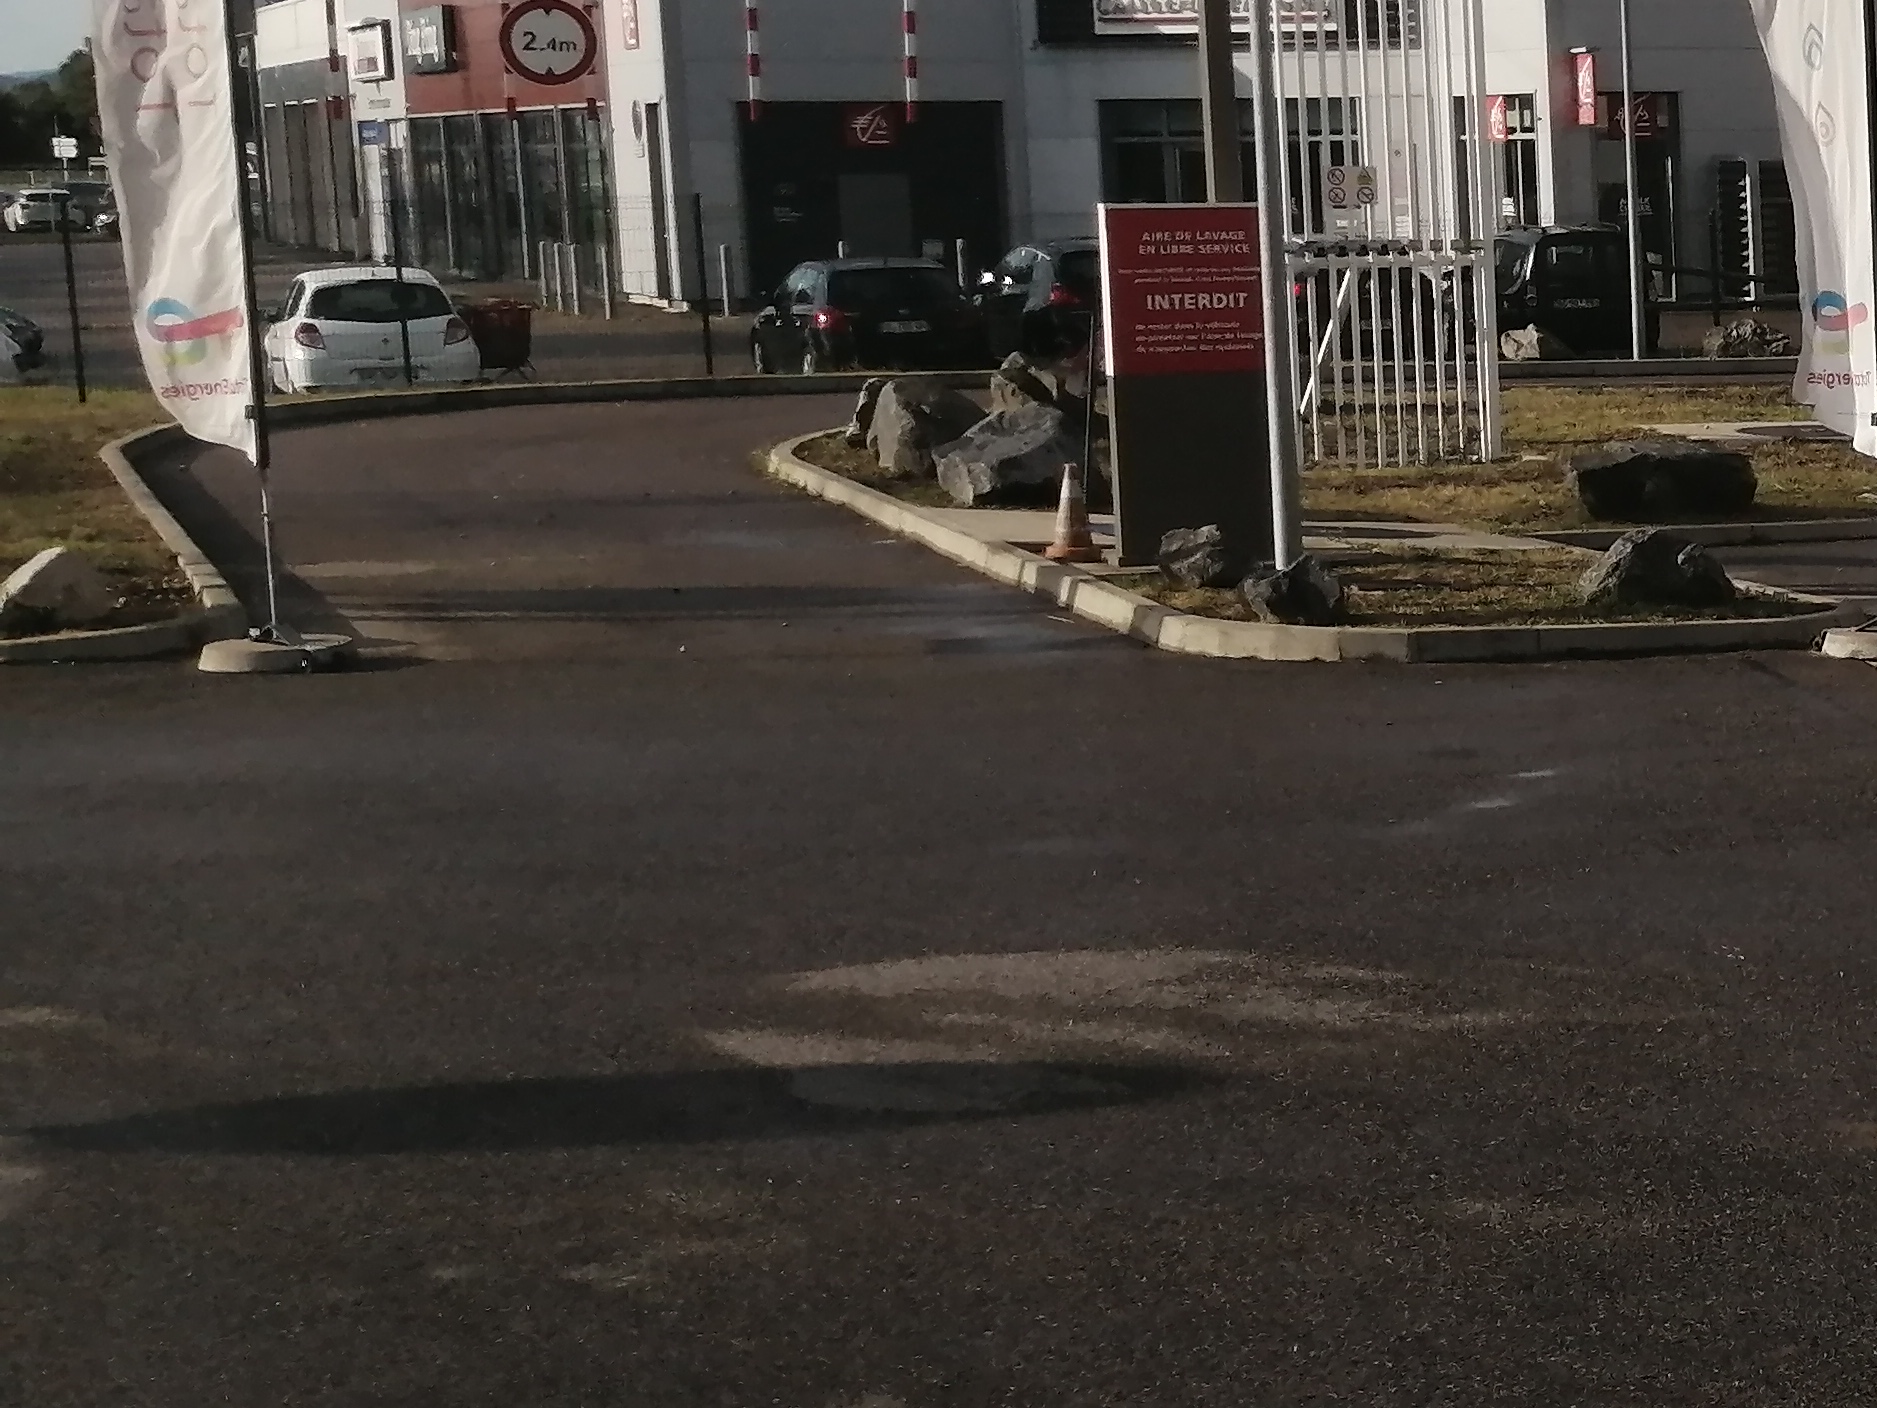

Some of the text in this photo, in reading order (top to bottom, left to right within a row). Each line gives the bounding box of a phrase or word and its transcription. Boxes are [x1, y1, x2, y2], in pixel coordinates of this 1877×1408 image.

[1142, 231, 1172, 242] AIRE
[1196, 230, 1246, 241] LAVAGE
[1138, 243, 1251, 255] EN LIBRE SERVICE
[1146, 292, 1248, 310] INTERDIT
